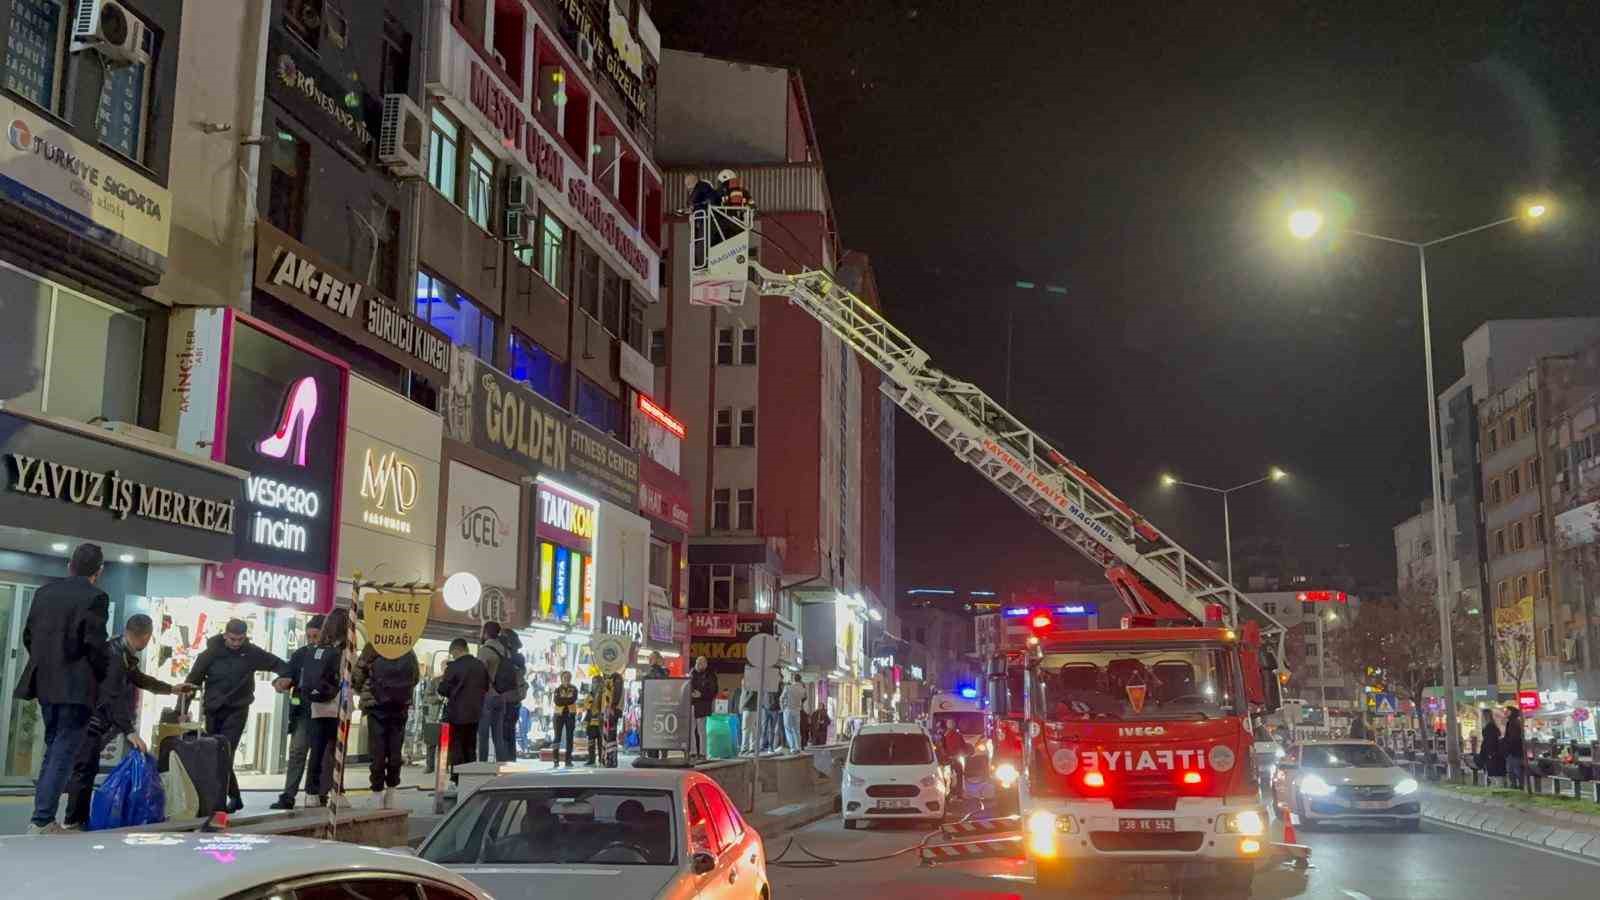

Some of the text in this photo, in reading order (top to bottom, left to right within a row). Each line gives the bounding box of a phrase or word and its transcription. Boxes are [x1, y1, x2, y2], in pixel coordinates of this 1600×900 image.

[470, 61, 525, 150] MESUT
[273, 251, 362, 318] AK-FEN
[368, 298, 450, 374] SÜRÜCÜ KURSU
[484, 386, 567, 472] GOLDEN
[570, 431, 607, 466] FITNESS
[608, 449, 639, 481] CENTER
[13, 453, 236, 535] YAVUZ İŞ MERKEZİ
[247, 475, 319, 519] VESPERO
[254, 511, 307, 553] incim
[1069, 504, 1115, 543] MAGIRUS
[236, 566, 317, 605] AYAKKABI
[374, 601, 420, 614] FAKÜLTE
[382, 615, 408, 630] RİNG
[374, 632, 412, 646] DURAĞI
[1118, 726, 1165, 737] IVECO
